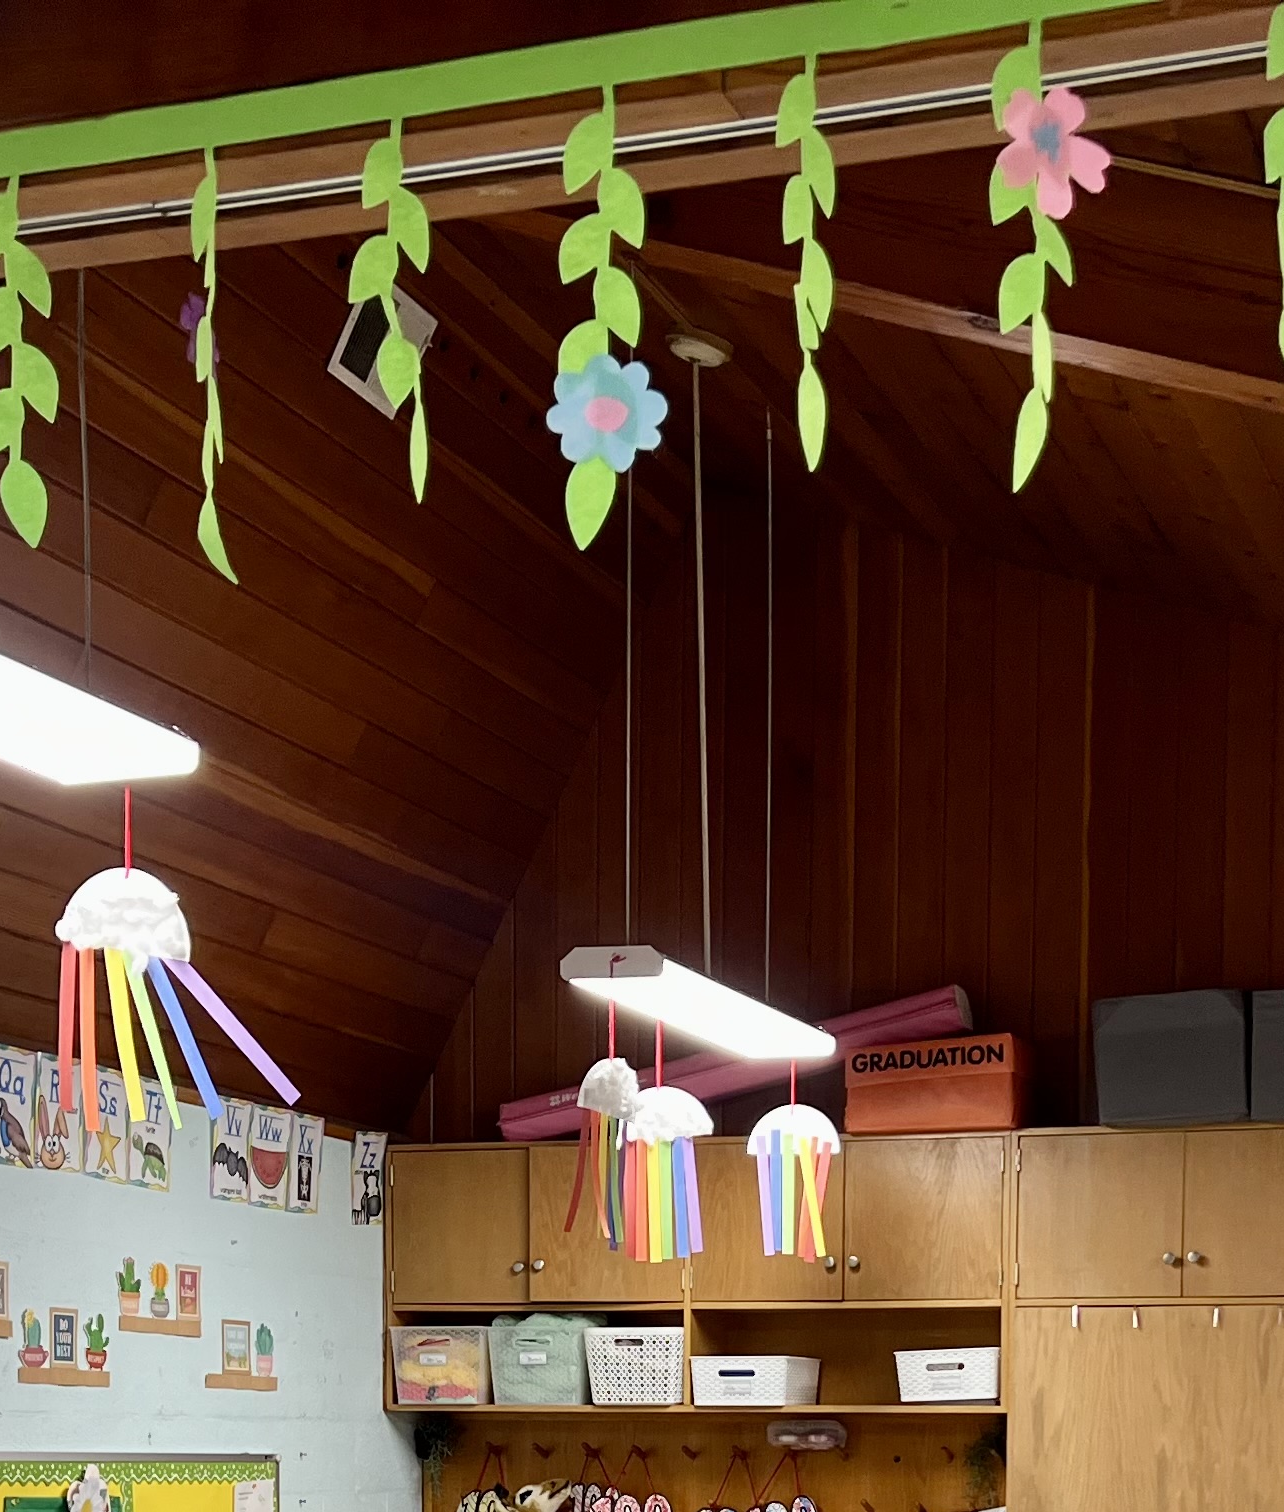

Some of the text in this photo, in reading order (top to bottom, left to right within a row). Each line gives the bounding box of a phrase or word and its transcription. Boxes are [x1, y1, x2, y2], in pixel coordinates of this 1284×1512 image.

[851, 1043, 1005, 1074] GRADUATION
[99, 1080, 118, 1117] Ss
[146, 1091, 163, 1124] Tt
[227, 1105, 242, 1137] Vv
[259, 1115, 282, 1143] Ww
[300, 1125, 314, 1155] Xx
[360, 1142, 377, 1169] Zz
